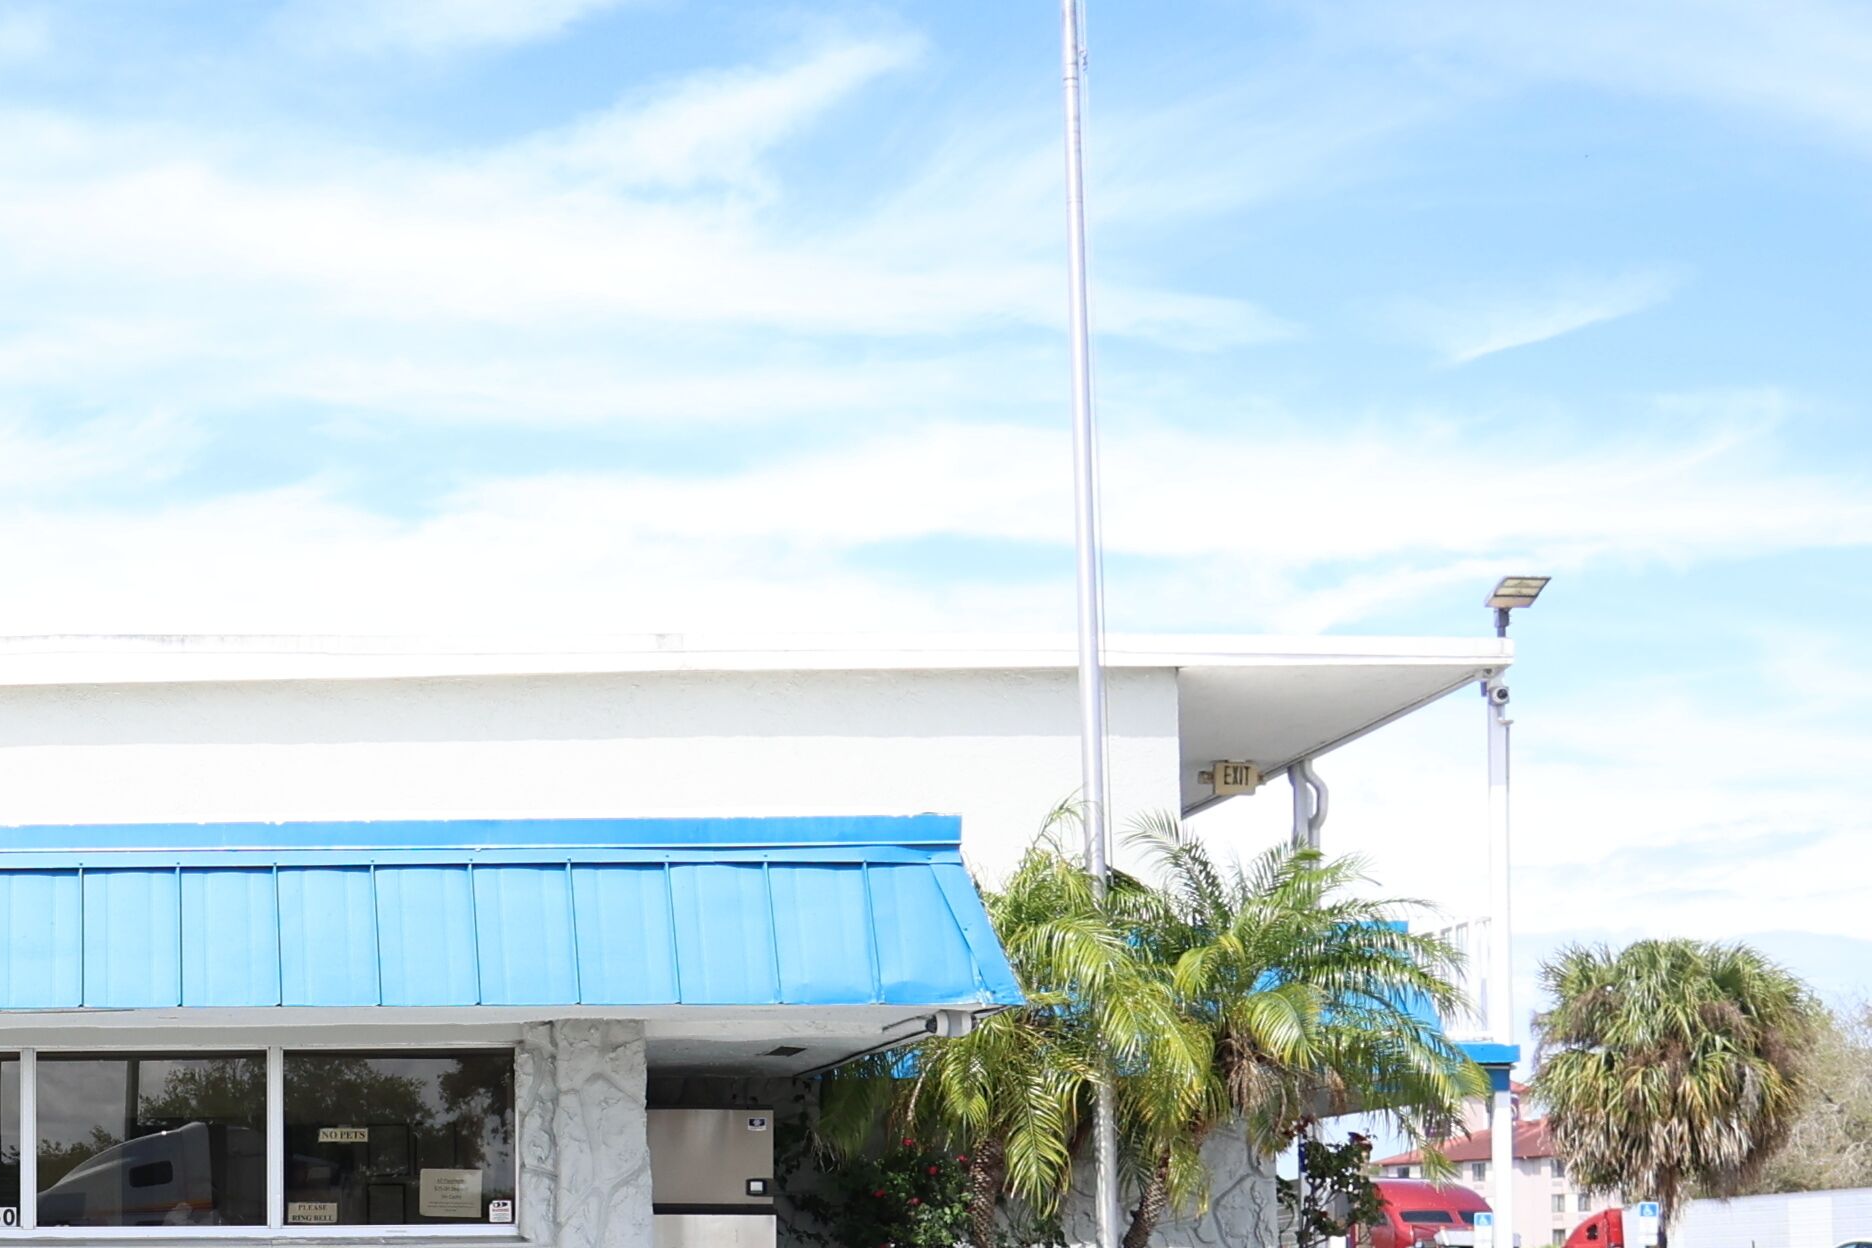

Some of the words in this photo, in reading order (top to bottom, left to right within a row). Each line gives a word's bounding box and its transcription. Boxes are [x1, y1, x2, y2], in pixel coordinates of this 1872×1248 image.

[1223, 765, 1250, 786] EXIT
[321, 1131, 338, 1139] NO
[340, 1131, 366, 1139] PETS
